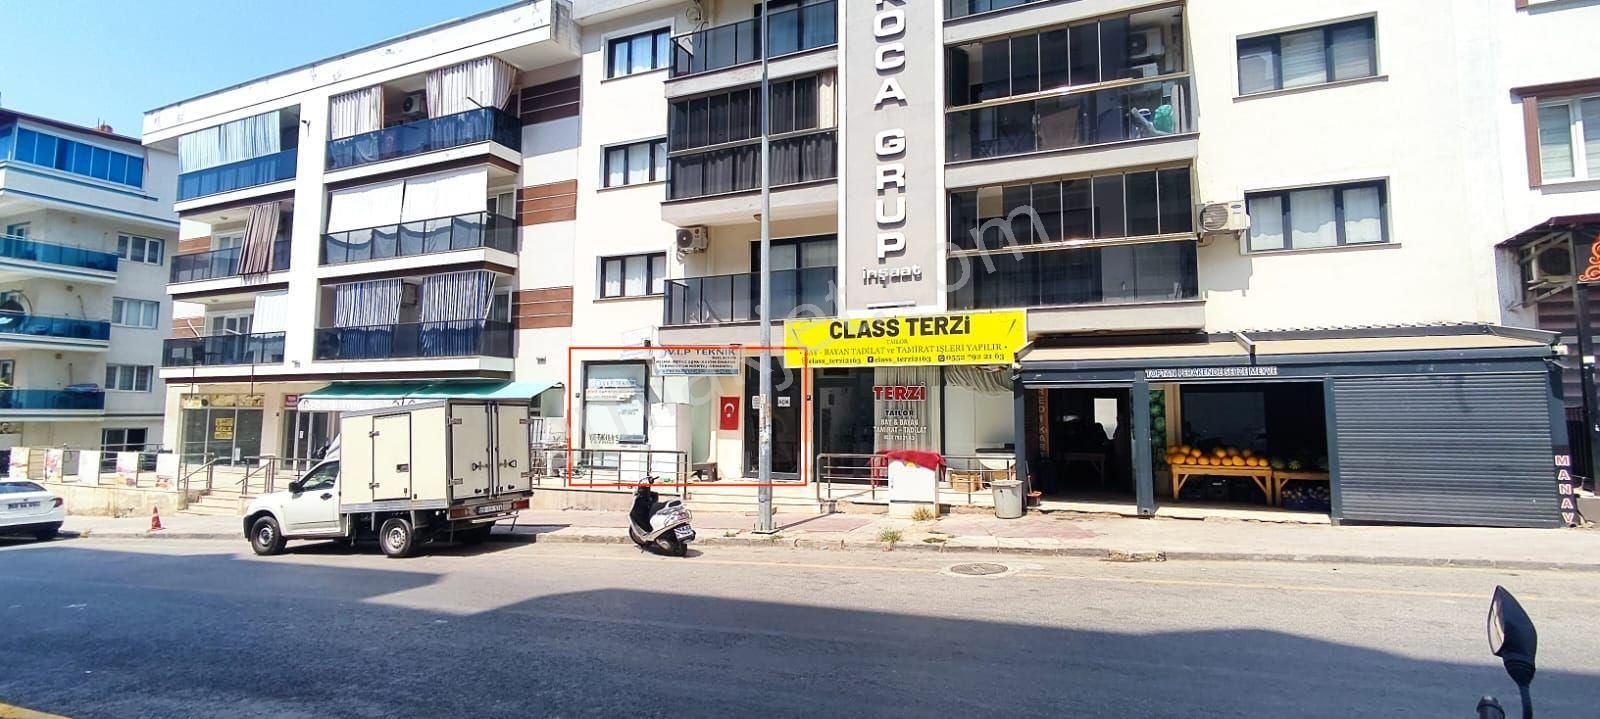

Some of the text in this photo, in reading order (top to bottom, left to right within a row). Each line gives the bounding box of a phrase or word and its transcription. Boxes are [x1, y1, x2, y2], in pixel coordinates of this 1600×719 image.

[875, 127, 907, 261] GRUP
[862, 262, 922, 284] inşaat
[829, 318, 900, 340] CLASS
[896, 344, 936, 354] TAMİRAT
[966, 343, 1002, 351] YAPILIR
[872, 381, 927, 402] TERZİ
[885, 409, 914, 417] TAILOR
[1554, 454, 1575, 524] MANAV
